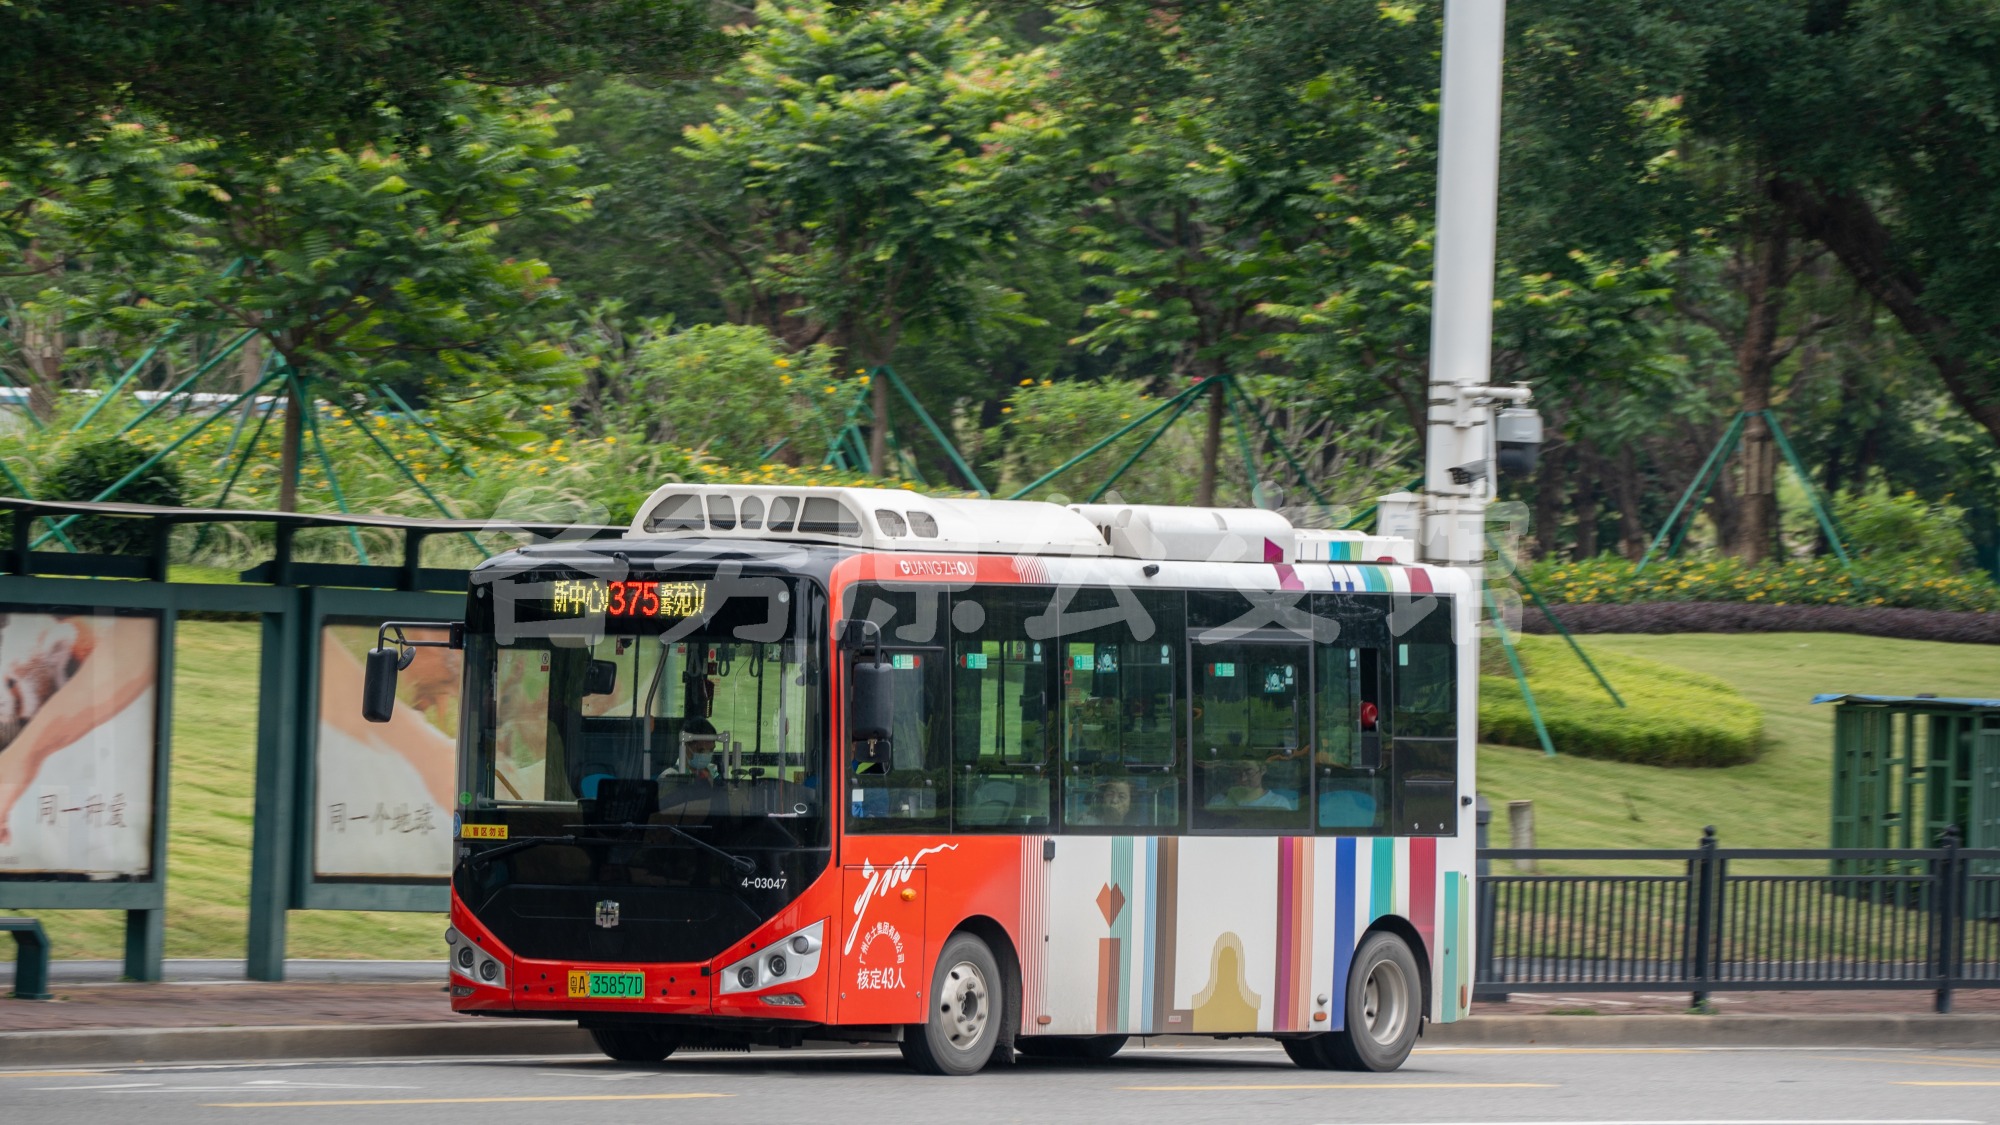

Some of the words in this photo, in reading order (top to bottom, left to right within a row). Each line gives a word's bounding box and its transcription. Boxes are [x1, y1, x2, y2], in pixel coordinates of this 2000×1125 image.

[900, 560, 975, 576] GUANGZHOU
[609, 581, 660, 617] 375
[473, 826, 505, 837] 盲区勿近
[741, 877, 787, 890] 4-03047
[858, 921, 905, 965] 广州巴士集团有限公司
[856, 967, 906, 990] 核定43人
